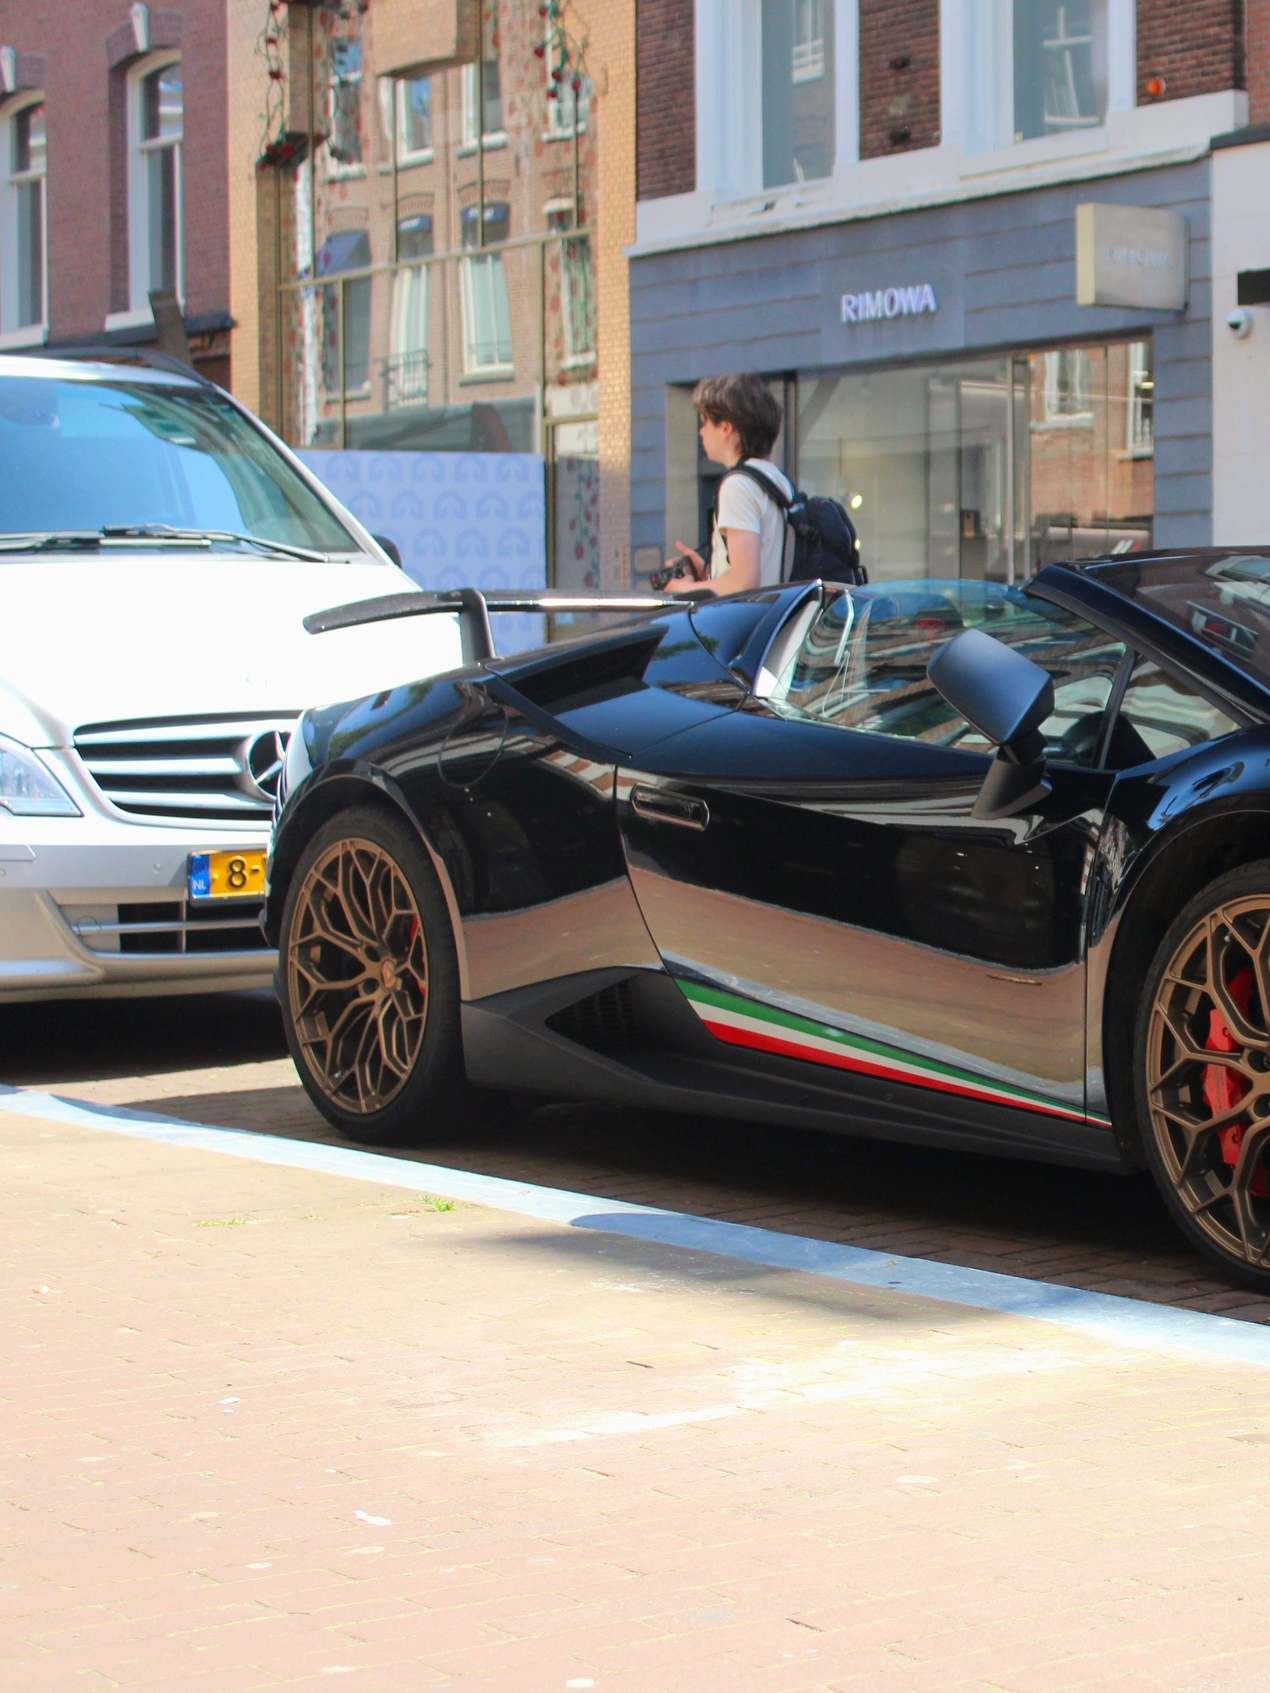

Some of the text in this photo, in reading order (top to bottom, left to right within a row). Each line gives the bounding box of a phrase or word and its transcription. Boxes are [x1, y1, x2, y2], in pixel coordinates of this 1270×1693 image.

[841, 283, 937, 324] RIMOWA
[193, 879, 207, 891] NL
[228, 856, 267, 888] 8-
